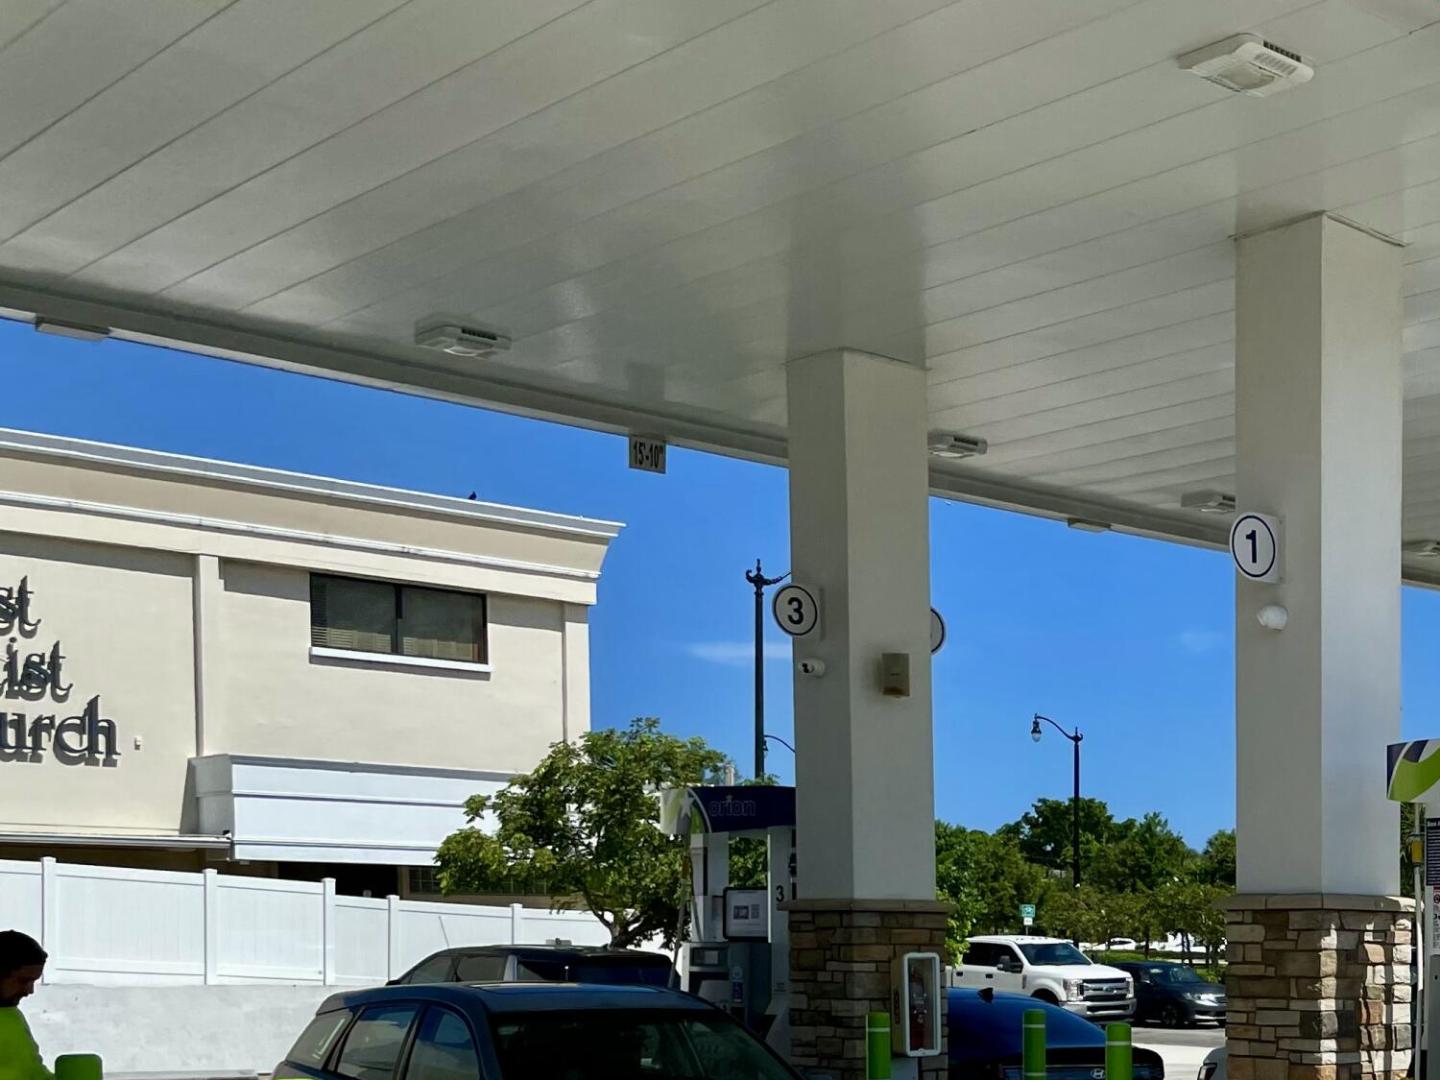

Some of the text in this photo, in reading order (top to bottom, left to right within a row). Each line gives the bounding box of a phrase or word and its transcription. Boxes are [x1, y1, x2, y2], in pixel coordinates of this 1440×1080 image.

[1245, 529, 1257, 563] 1
[787, 597, 804, 625] 3
[708, 792, 757, 817] orion
[776, 884, 785, 903] 3
